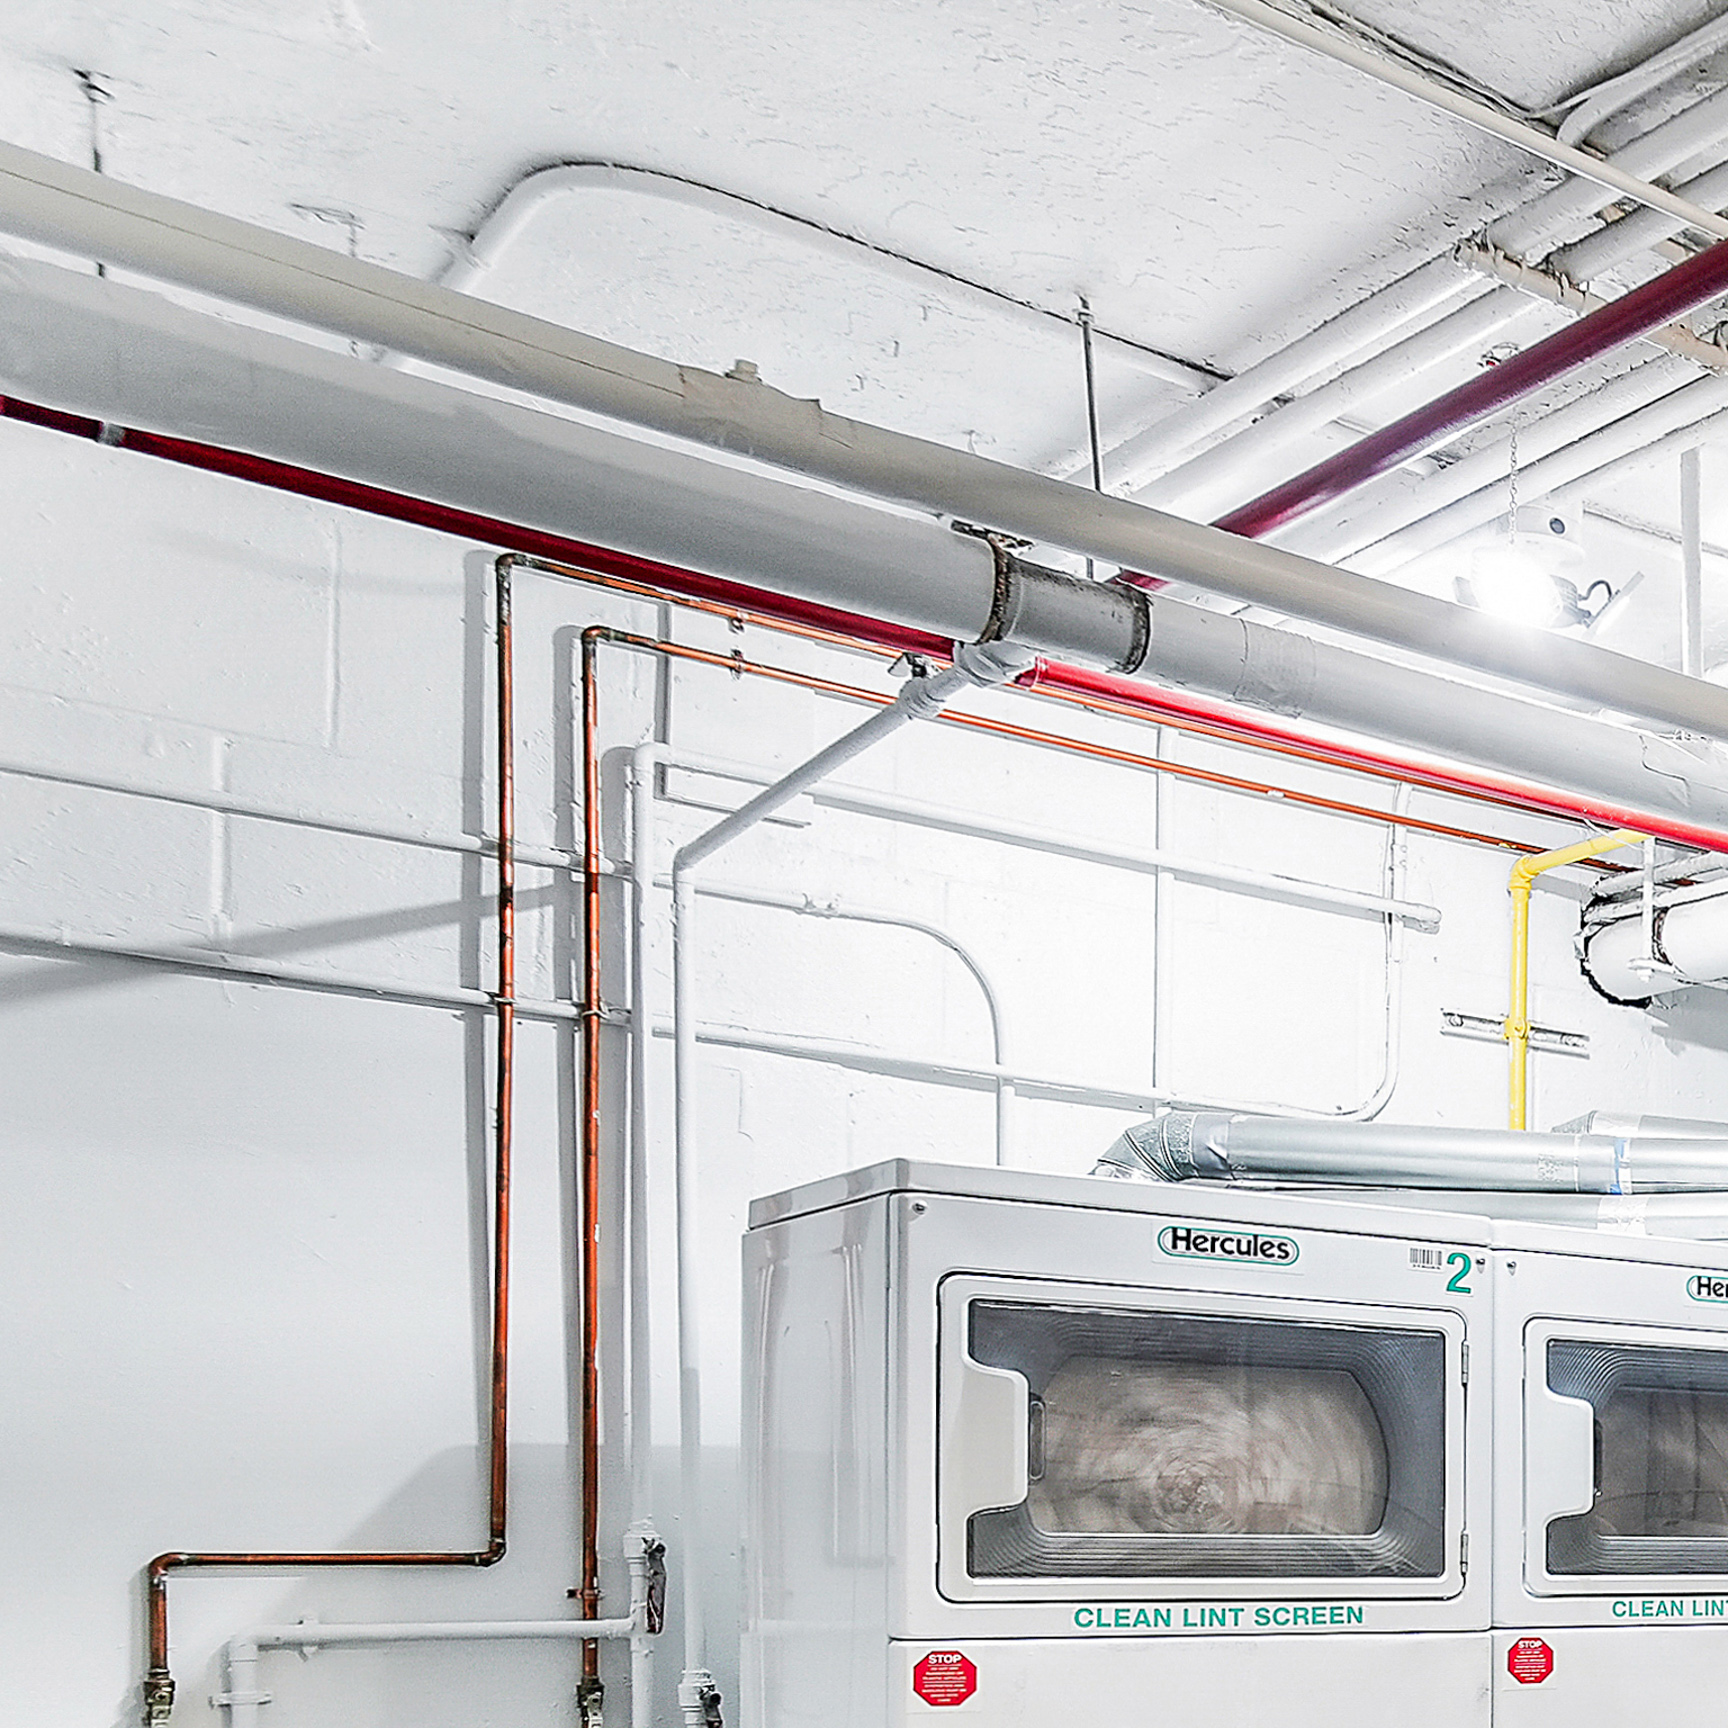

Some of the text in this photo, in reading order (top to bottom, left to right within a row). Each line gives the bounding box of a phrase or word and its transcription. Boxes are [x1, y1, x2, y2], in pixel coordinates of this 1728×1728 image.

[1171, 1227, 1290, 1260] Hercules
[1446, 1252, 1471, 1294] 2
[1074, 1606, 1363, 1628] CLEAN LINT SCREEN
[1612, 1600, 1684, 1617] CLEAN
[1518, 1640, 1543, 1648] STOP
[928, 1654, 962, 1664] STOP
